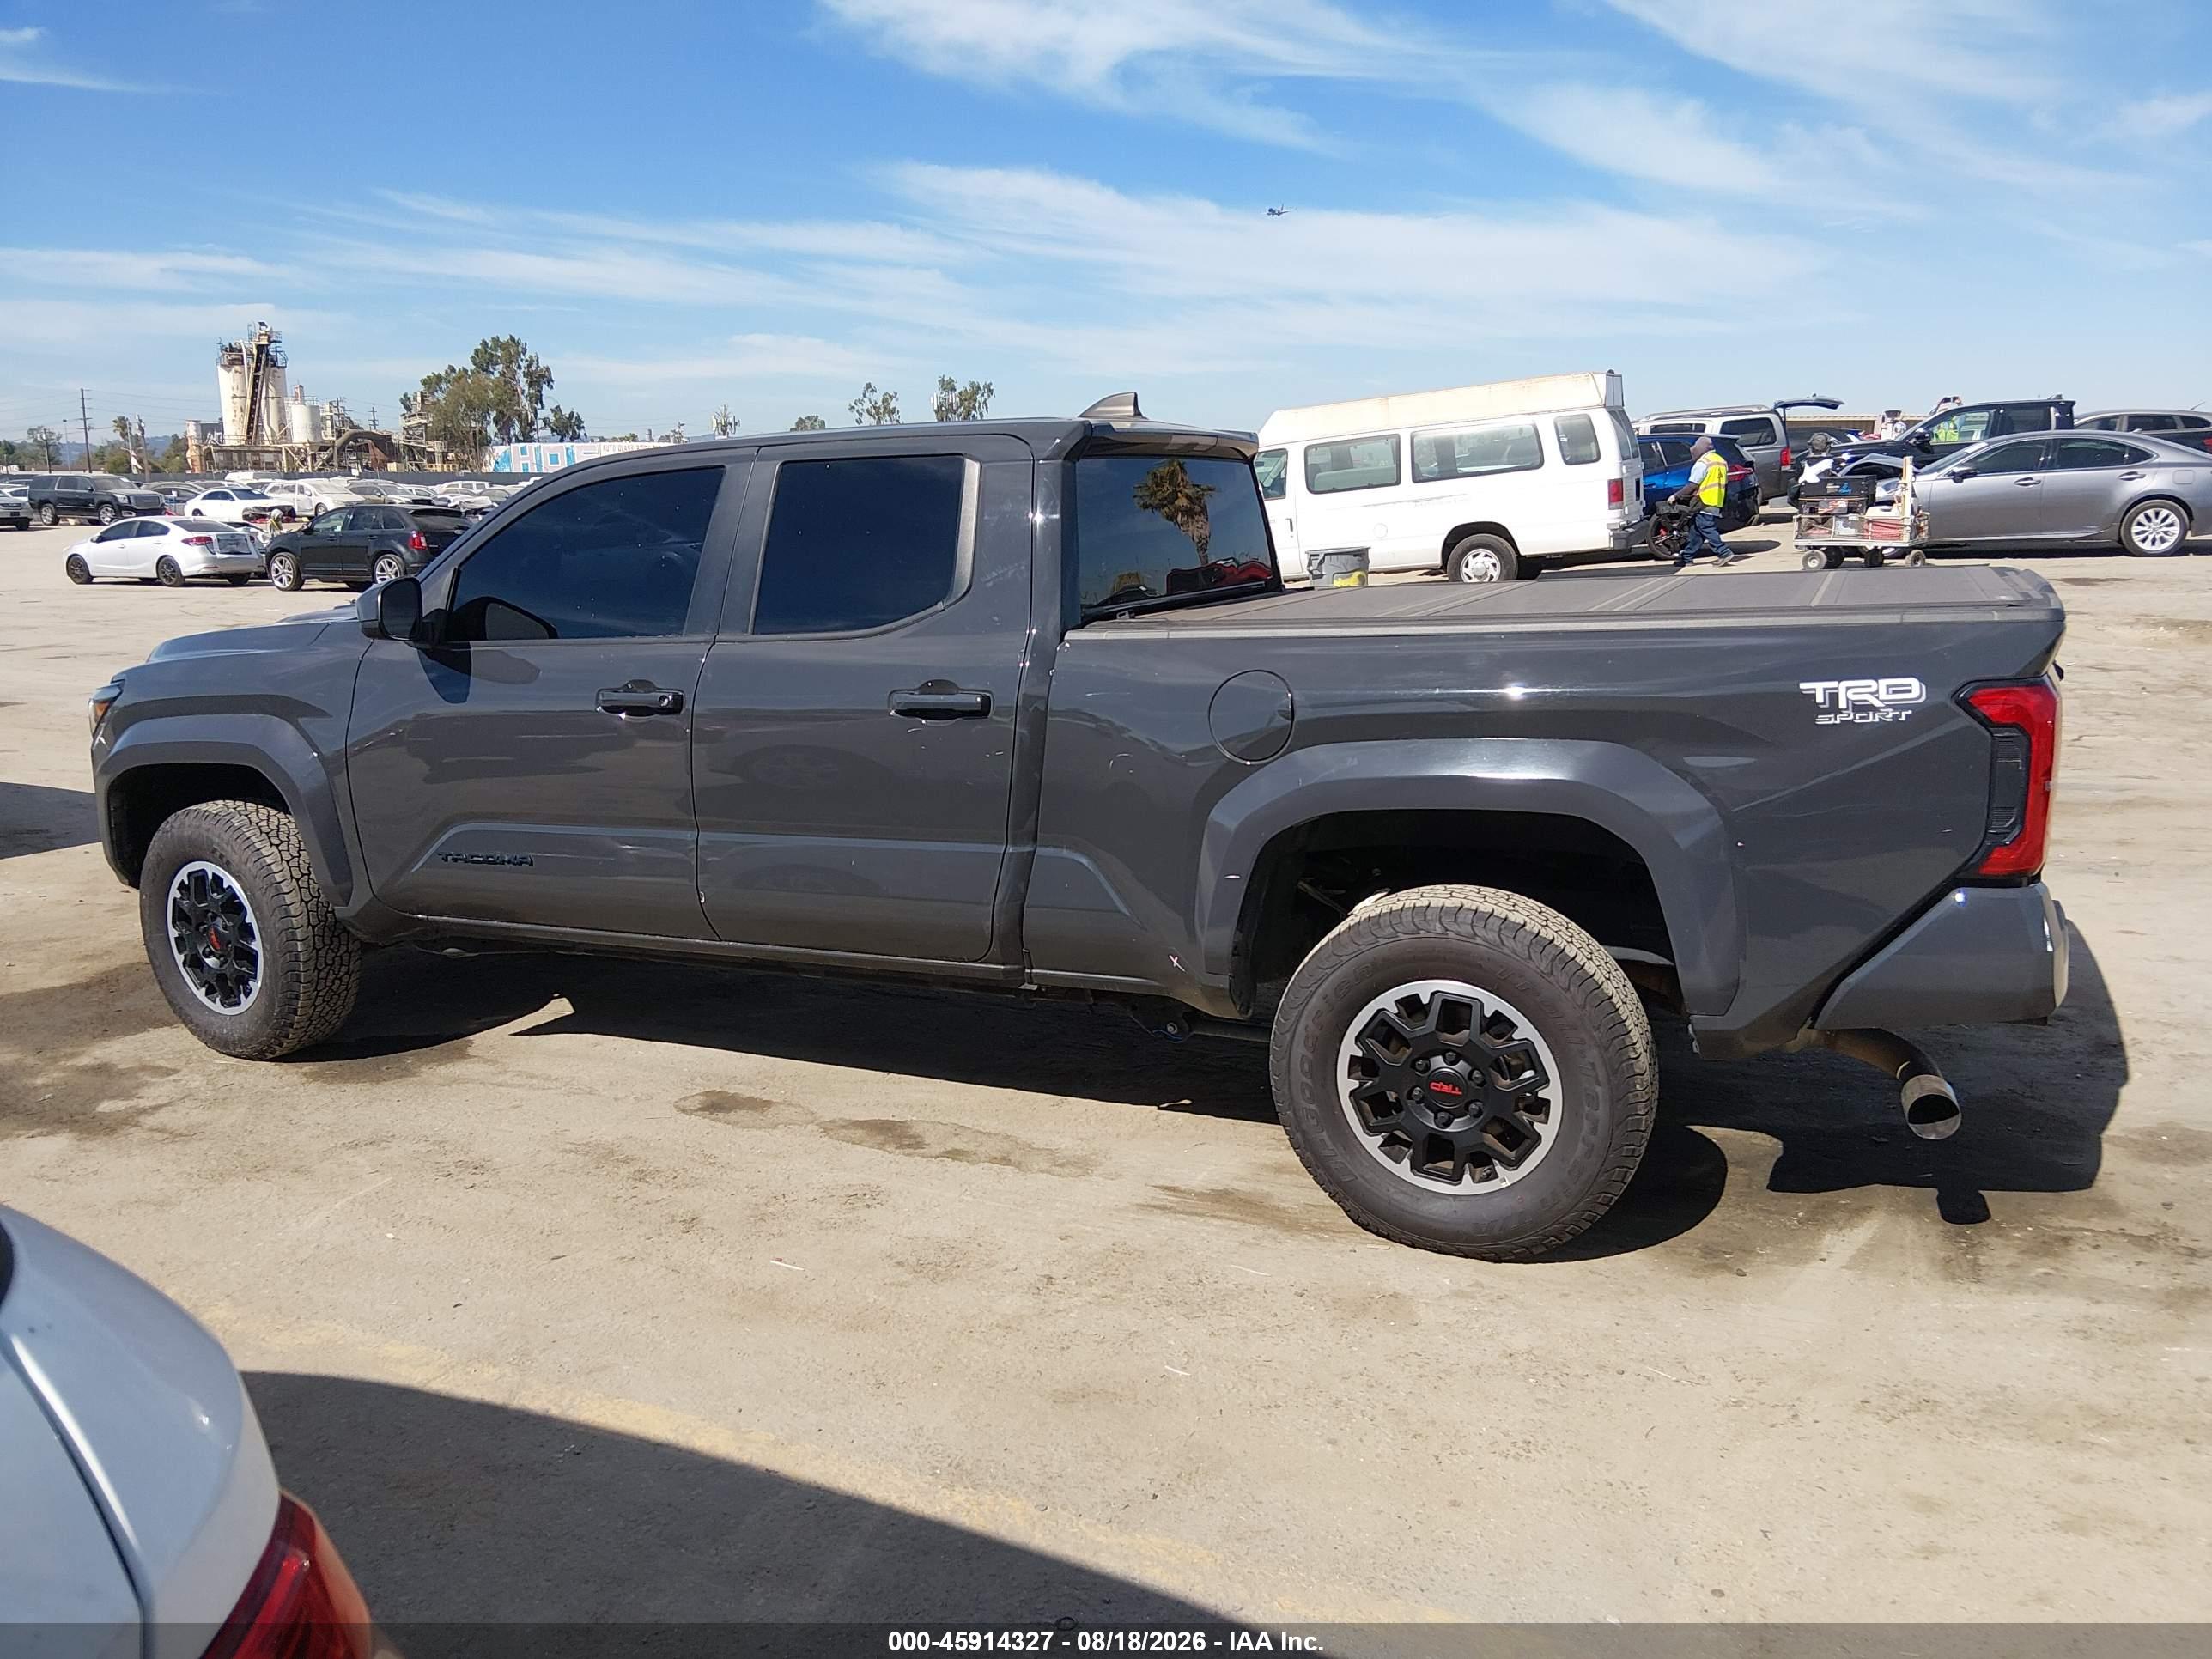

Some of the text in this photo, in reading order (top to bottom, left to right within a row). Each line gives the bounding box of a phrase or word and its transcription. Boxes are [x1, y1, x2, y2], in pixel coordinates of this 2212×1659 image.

[1799, 676, 1926, 711] TRD
[1814, 708, 1914, 725] SPORT
[438, 852, 534, 866] TACOMA
